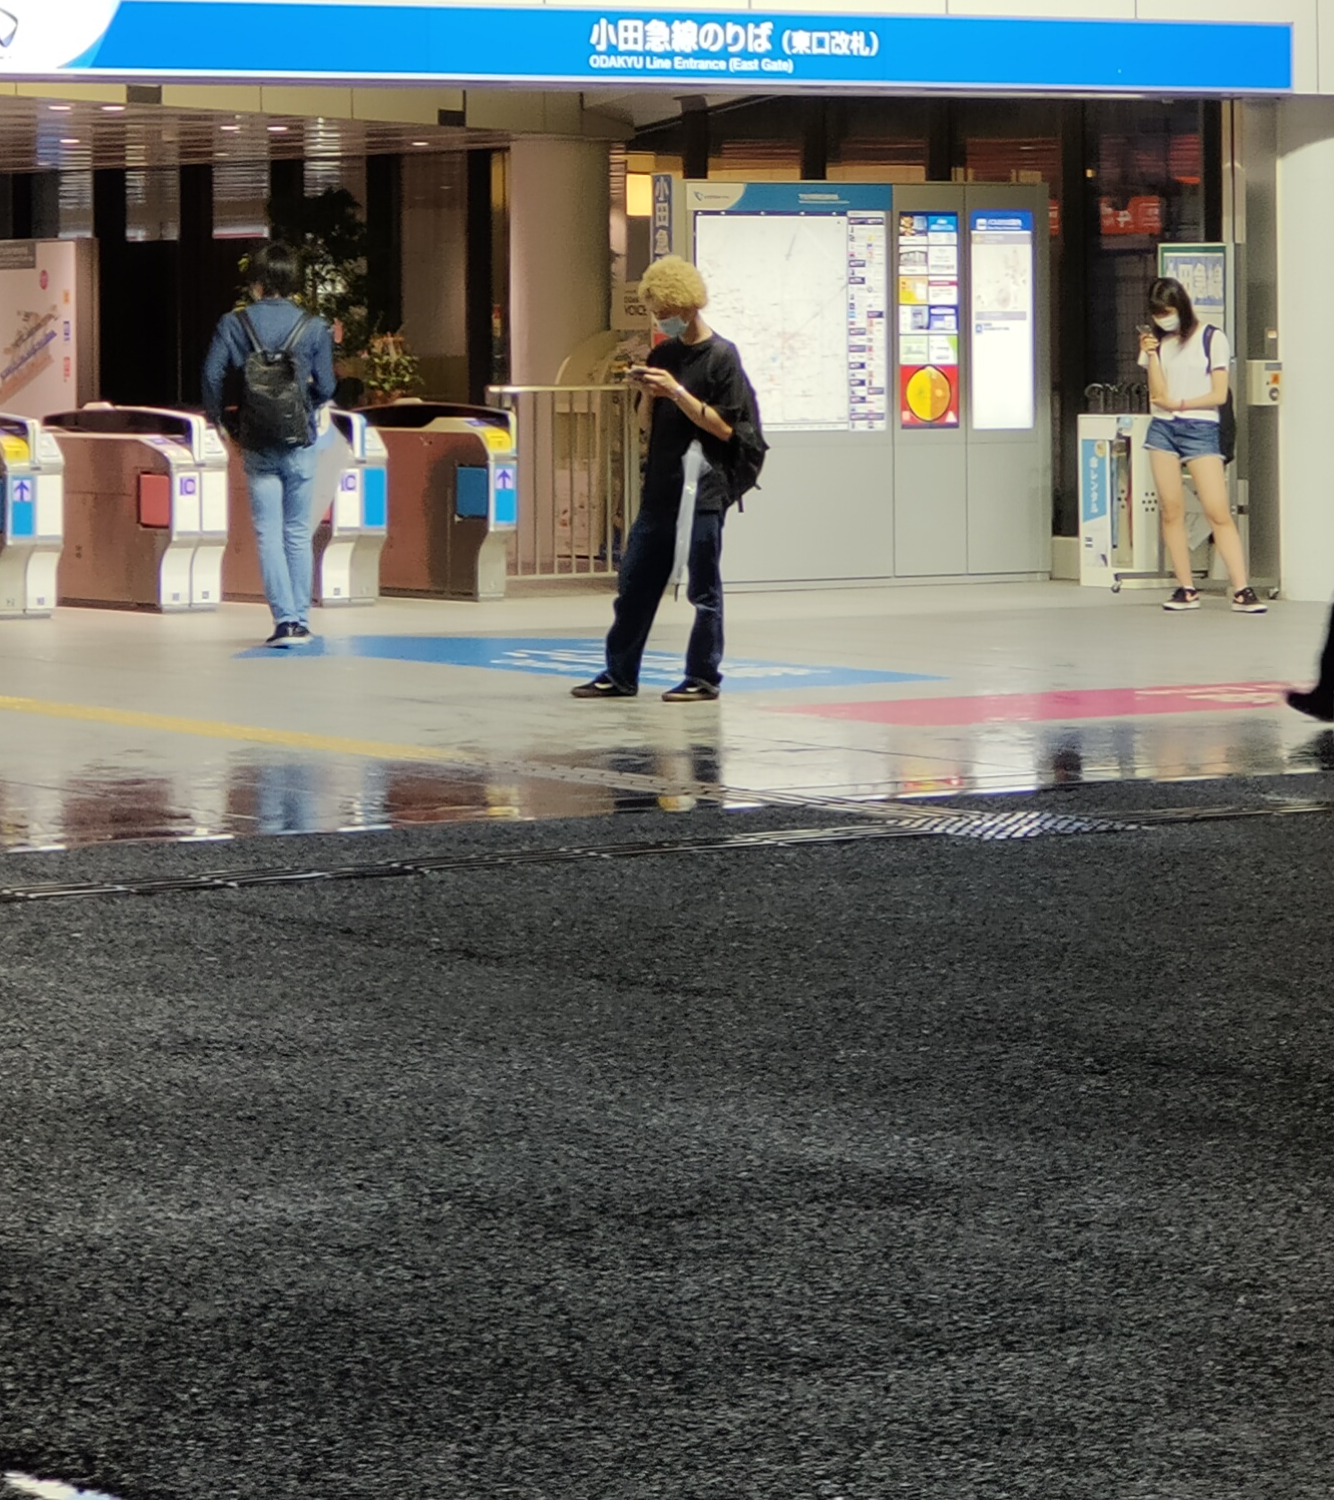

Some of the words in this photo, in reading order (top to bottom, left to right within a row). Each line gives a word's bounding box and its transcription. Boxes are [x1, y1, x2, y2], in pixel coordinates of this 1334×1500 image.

[589, 18, 774, 53] 小田急線のりば
[589, 54, 644, 69] ODAKYU
[646, 55, 672, 70] Line
[674, 56, 727, 72] Entrance
[729, 57, 759, 73] (East
[761, 58, 794, 74] Gate)
[654, 176, 670, 260] 小田急
[179, 476, 196, 496] IC
